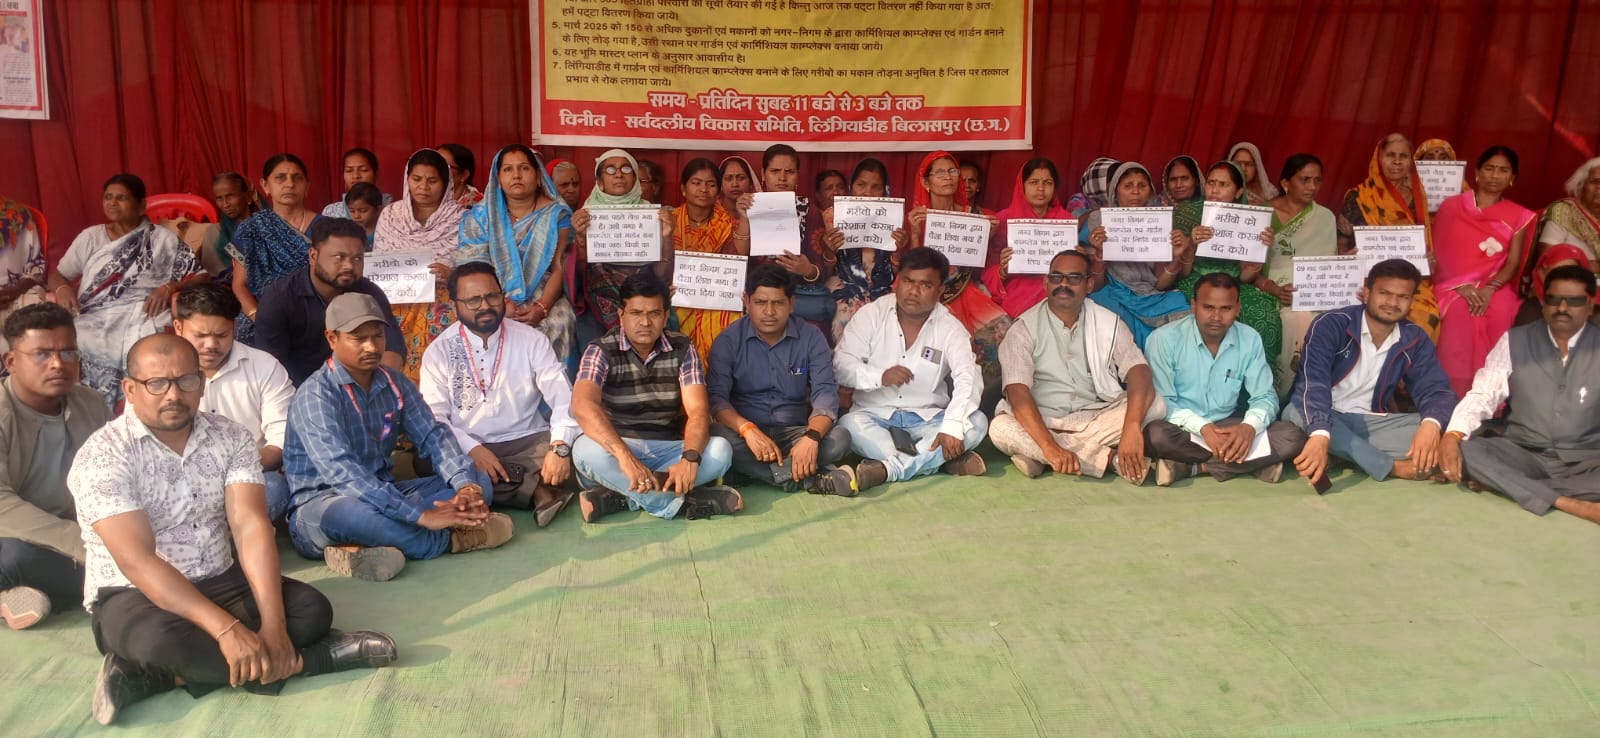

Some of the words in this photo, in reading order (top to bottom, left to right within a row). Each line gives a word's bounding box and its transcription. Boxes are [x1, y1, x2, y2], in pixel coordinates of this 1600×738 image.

[765, 0, 777, 10] गई
[789, 0, 811, 12] किन्तु
[814, 2, 833, 10] आज
[878, 1, 906, 11] वितरण
[909, 1, 924, 11] नहीं
[926, 2, 946, 11] किया
[949, 3, 964, 11] गया
[967, 2, 973, 10] है
[562, 6, 575, 16] हमें
[602, 7, 631, 17] वितरण
[634, 9, 655, 19] किया
[551, 21, 561, 30] 5.
[564, 20, 581, 30] मार्च
[584, 23, 608, 31] 2025
[611, 21, 622, 31] को
[626, 24, 643, 32] 150
[645, 24, 653, 32] से
[656, 24, 683, 34] अधिक
[715, 27, 727, 36] एवं
[760, 27, 771, 36] को
[824, 28, 833, 37] के
[945, 29, 956, 38] एवं
[959, 27, 982, 37] गार्डन
[984, 27, 1005, 37] बनाने
[562, 34, 571, 43] के
[574, 35, 590, 44] लिए
[613, 37, 629, 45] गया
[662, 40, 685, 48] स्थान
[687, 40, 698, 48] पर
[701, 39, 724, 48] गार्डन
[727, 40, 739, 50] एवं
[835, 43, 859, 51] बनाया
[552, 48, 561, 56] 6.
[564, 48, 577, 56] यह
[580, 47, 597, 58] भूमि
[600, 49, 625, 58] मास्टर
[628, 51, 649, 59] प्लान
[652, 50, 660, 59] के
[663, 53, 693, 63] अनुसार
[696, 52, 734, 62] आवासीय
[553, 61, 561, 70] 7.
[623, 62, 646, 72] गार्डन
[649, 64, 661, 73] एवं
[756, 67, 778, 76] बनाने
[781, 67, 790, 76] के
[792, 67, 809, 77] लिए
[837, 69, 848, 77] का
[905, 67, 936, 79] अनुचित
[938, 67, 945, 77] है
[948, 67, 966, 77] जिस
[968, 69, 979, 77] पर
[981, 68, 1009, 77] तत्काल
[566, 75, 589, 84] प्रभाव
[592, 75, 599, 83] से
[601, 75, 618, 85] रोक
[620, 78, 648, 86] लगाया
[650, 92, 686, 108] समय
[699, 89, 752, 109] प्रतिदिन
[756, 96, 790, 114] सुबह
[794, 97, 807, 111] 11
[811, 91, 836, 111] बजे
[839, 92, 852, 111] से
[855, 97, 865, 111] 3
[868, 91, 893, 111] बजे
[895, 96, 922, 110] तक
[559, 109, 606, 128] विनीत
[624, 112, 695, 131] सर्वदलीय
[700, 113, 751, 132] विकास
[755, 115, 805, 134] समिति,
[808, 115, 888, 133] लिंगियाडीह
[891, 116, 961, 136] बिलासपुर
[964, 116, 1010, 133] (छ.ग.)
[875, 207, 887, 217] को
[1244, 216, 1257, 226] को
[871, 223, 894, 232] करना
[404, 258, 418, 267] को
[680, 263, 696, 272] नगर
[700, 264, 720, 274] निगम
[700, 288, 715, 297] दिया
